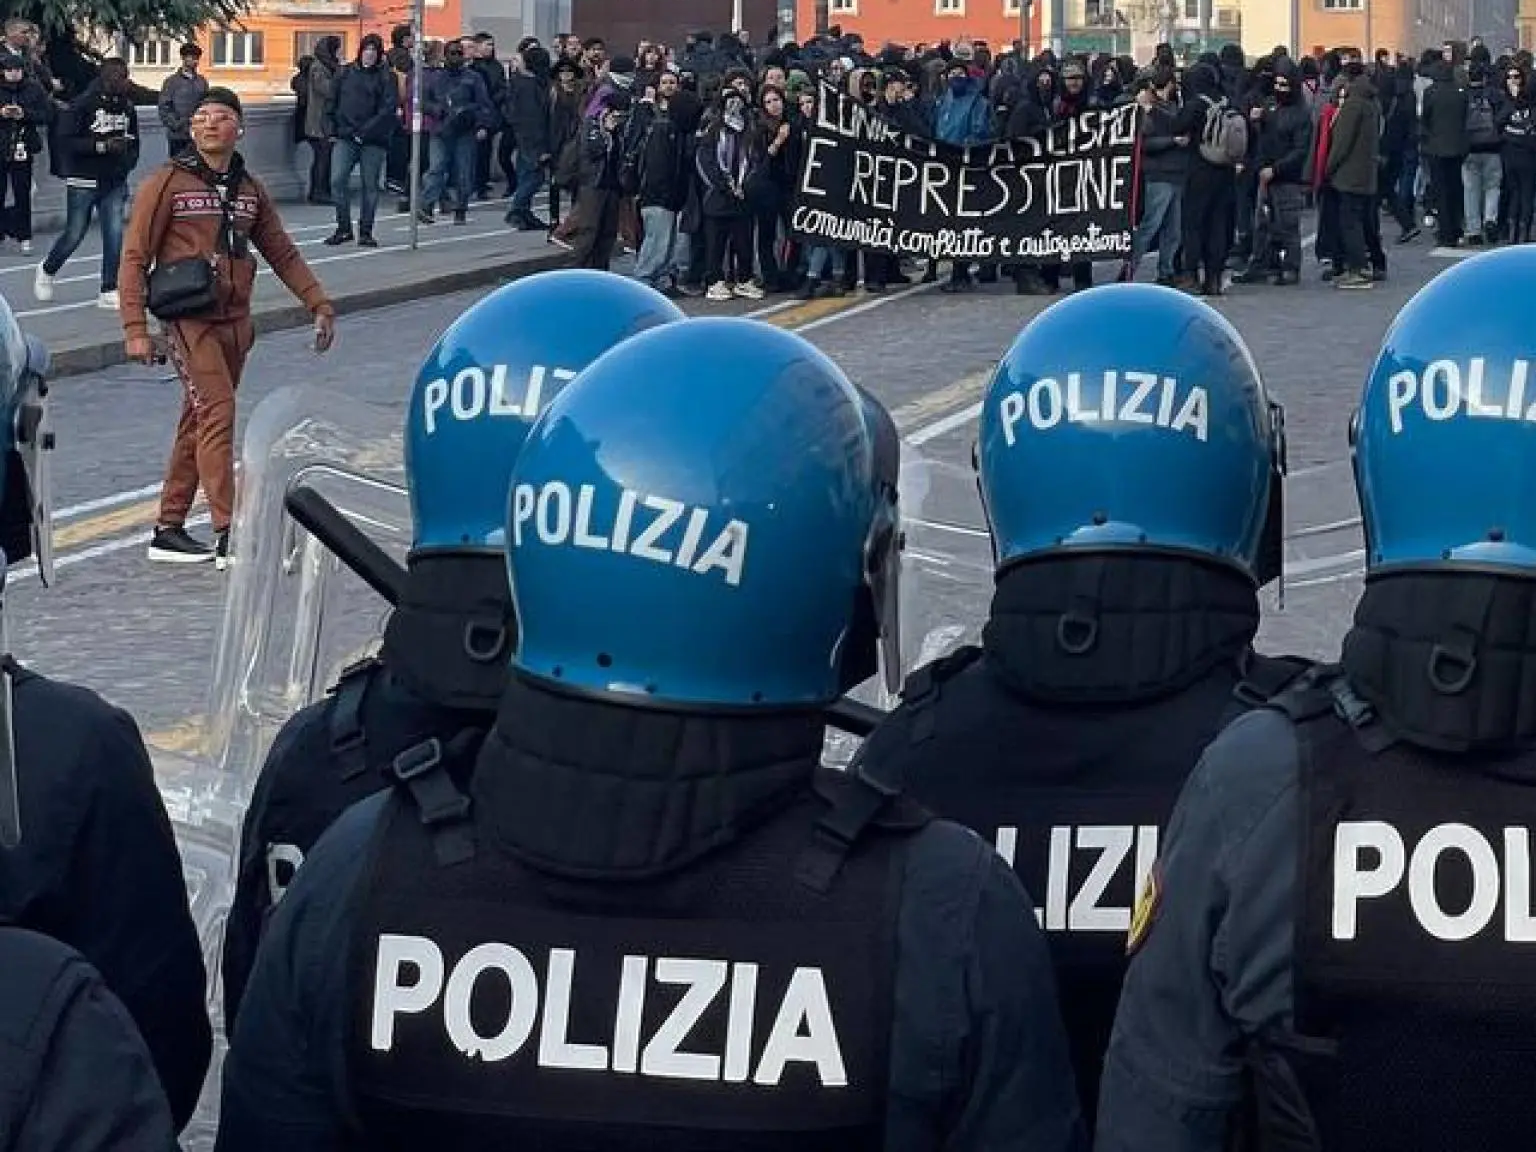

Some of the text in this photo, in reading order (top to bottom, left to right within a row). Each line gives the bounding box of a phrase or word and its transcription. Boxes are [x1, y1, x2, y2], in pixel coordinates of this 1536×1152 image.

[801, 137, 1132, 217] E REPRESSIONE
[900, 227, 995, 259] conflitto
[1000, 237, 1011, 256] e
[1017, 222, 1131, 262] autogestione
[425, 364, 577, 434] POLI
[1000, 371, 1209, 447] POLIZIA
[515, 481, 749, 586] POLIZIA
[370, 933, 848, 1086] POLIZIA
